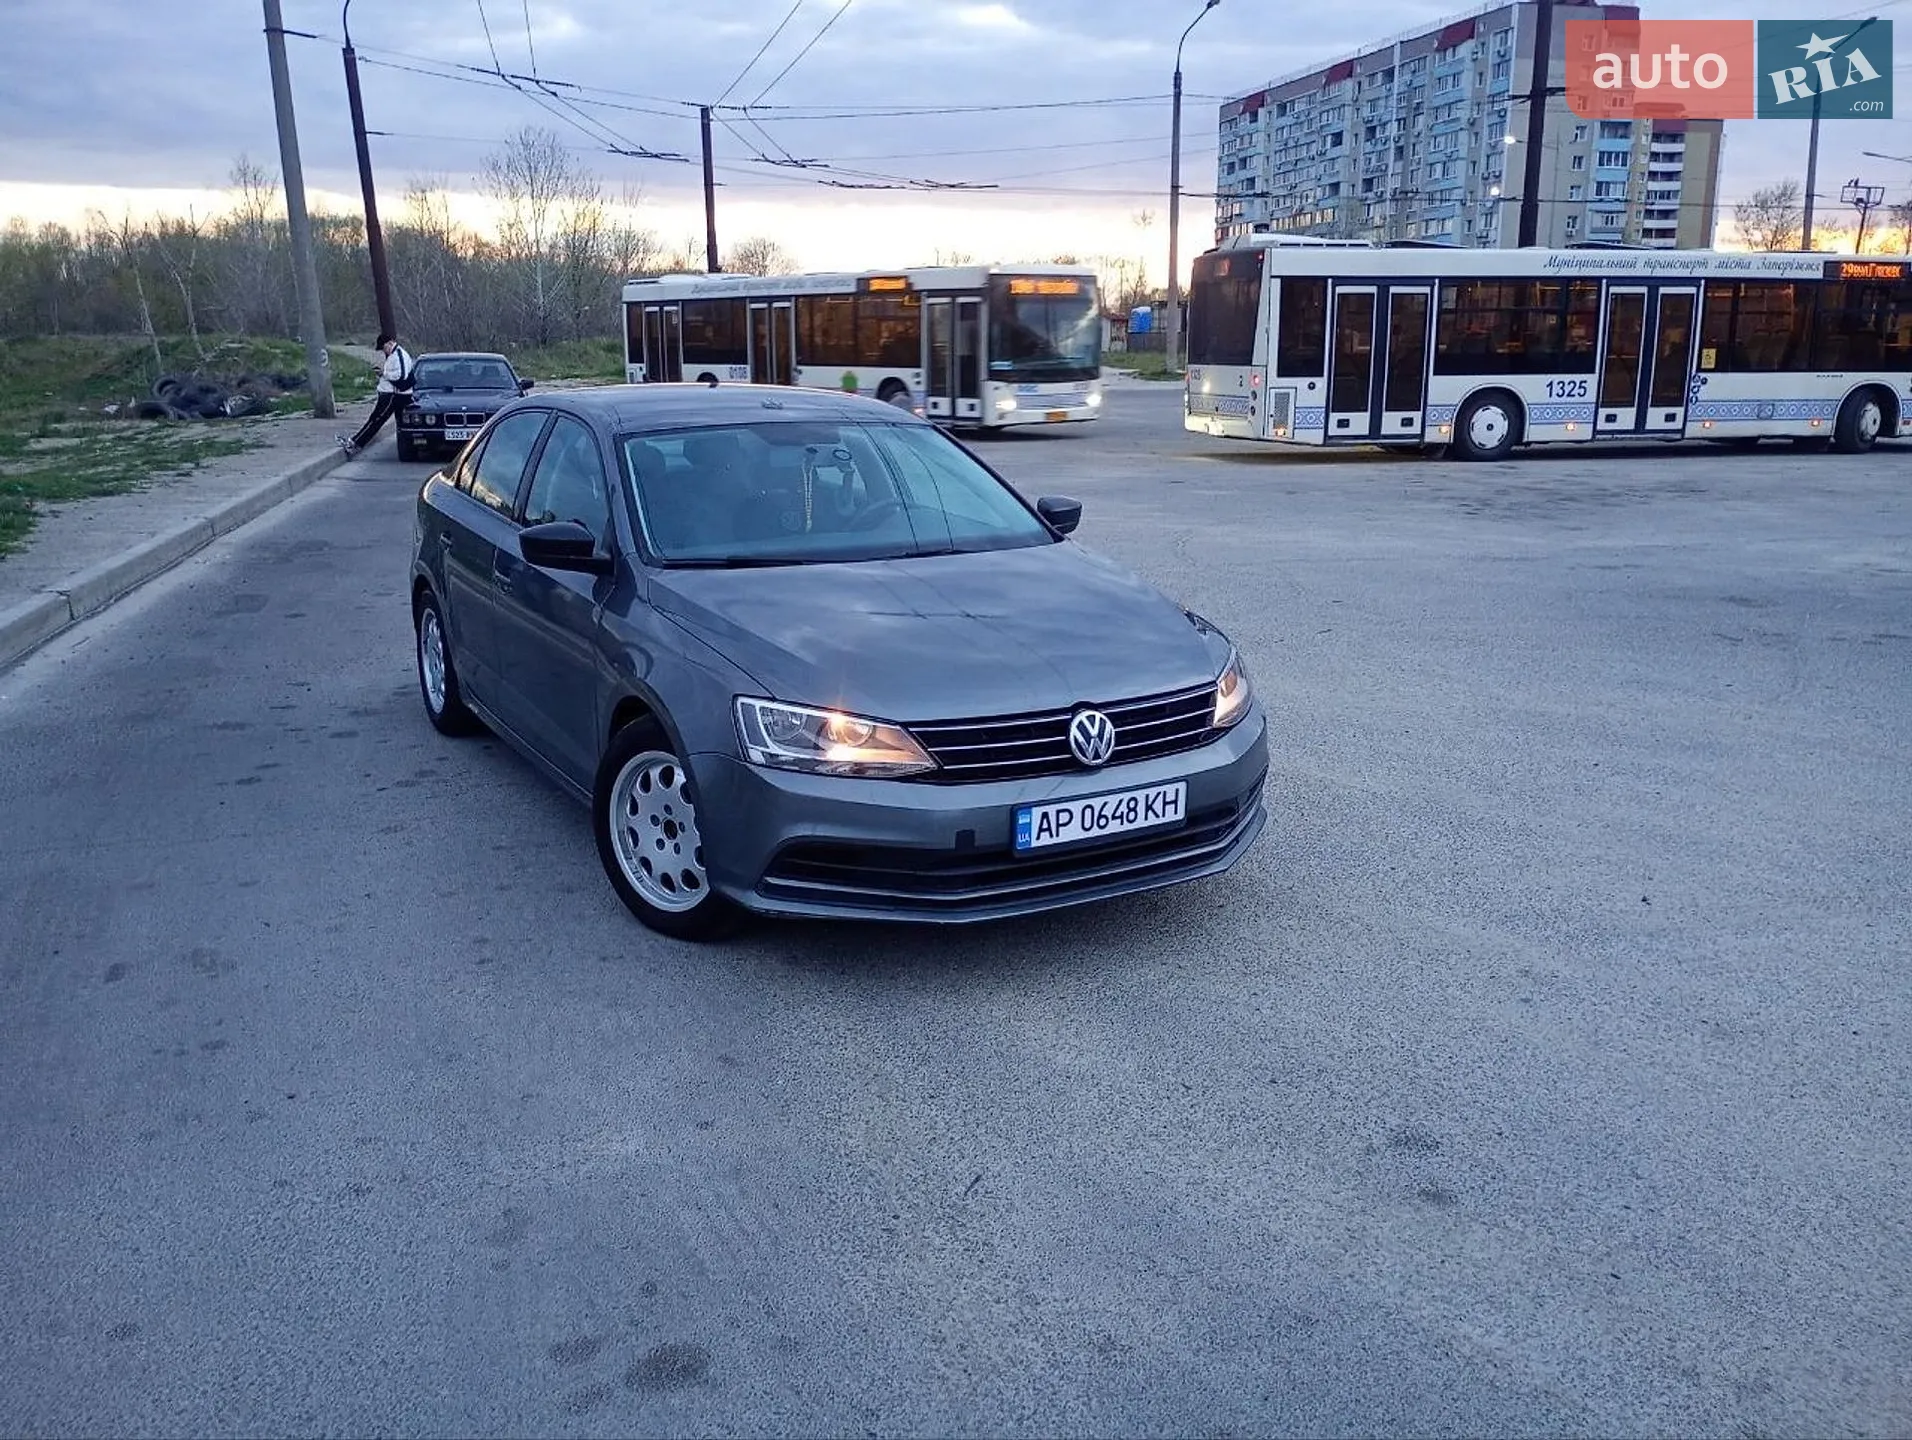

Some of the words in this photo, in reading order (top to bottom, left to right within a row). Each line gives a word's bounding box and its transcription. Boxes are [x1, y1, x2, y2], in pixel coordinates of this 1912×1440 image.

[1543, 255, 1638, 274] Муніципальний
[1643, 256, 1709, 275] транспорт
[1715, 257, 1750, 271] міста
[1546, 380, 1588, 398] 1325
[1035, 808, 1074, 841] AP
[1081, 797, 1139, 832] 0648
[1144, 788, 1180, 821] KH
